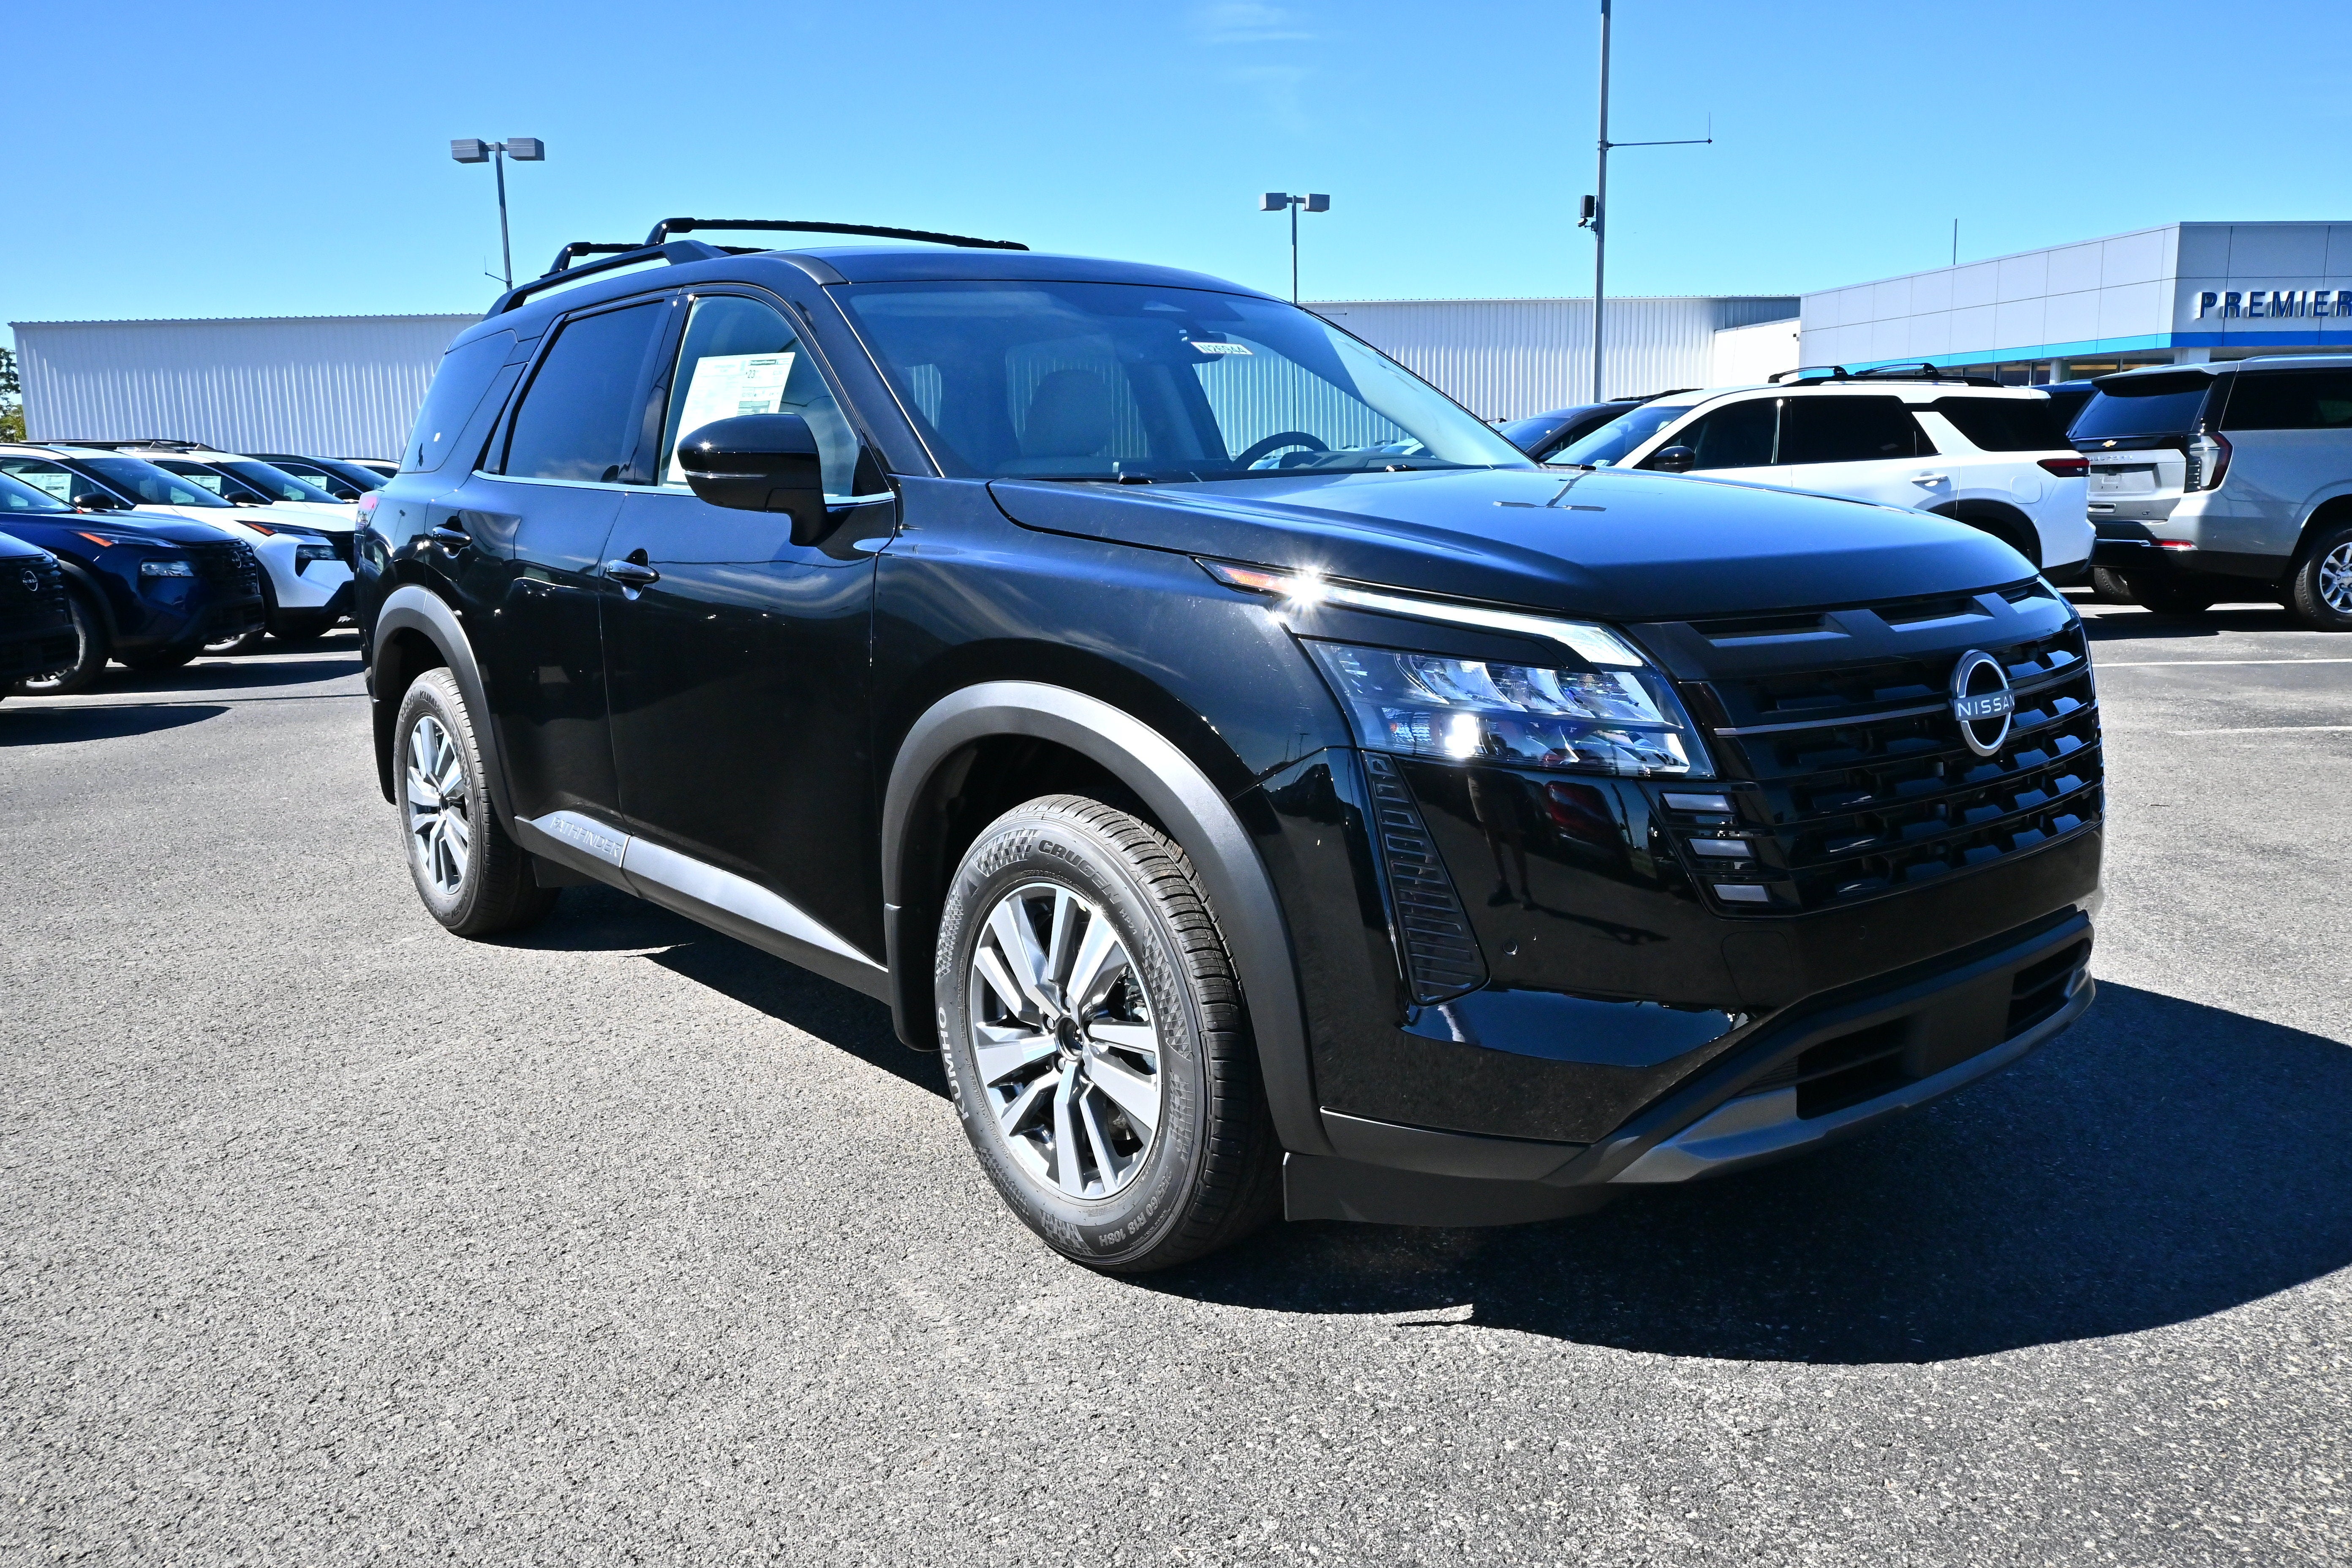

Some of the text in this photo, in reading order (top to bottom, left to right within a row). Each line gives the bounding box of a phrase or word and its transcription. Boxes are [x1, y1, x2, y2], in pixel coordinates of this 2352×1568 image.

[2200, 291, 2352, 318] PREMIER
[1198, 345, 1247, 354] N26944
[419, 690, 445, 720] KUMHO
[1957, 694, 2015, 717] NISSAN
[550, 817, 622, 858] PATHFINDER
[1038, 840, 1122, 904] CRUGEN
[1119, 908, 1138, 935] HP71
[938, 1007, 969, 1121] KUMHO
[1146, 1165, 1173, 1217] 255/60
[1127, 1211, 1147, 1235] R18
[1099, 1228, 1126, 1247] 108H
